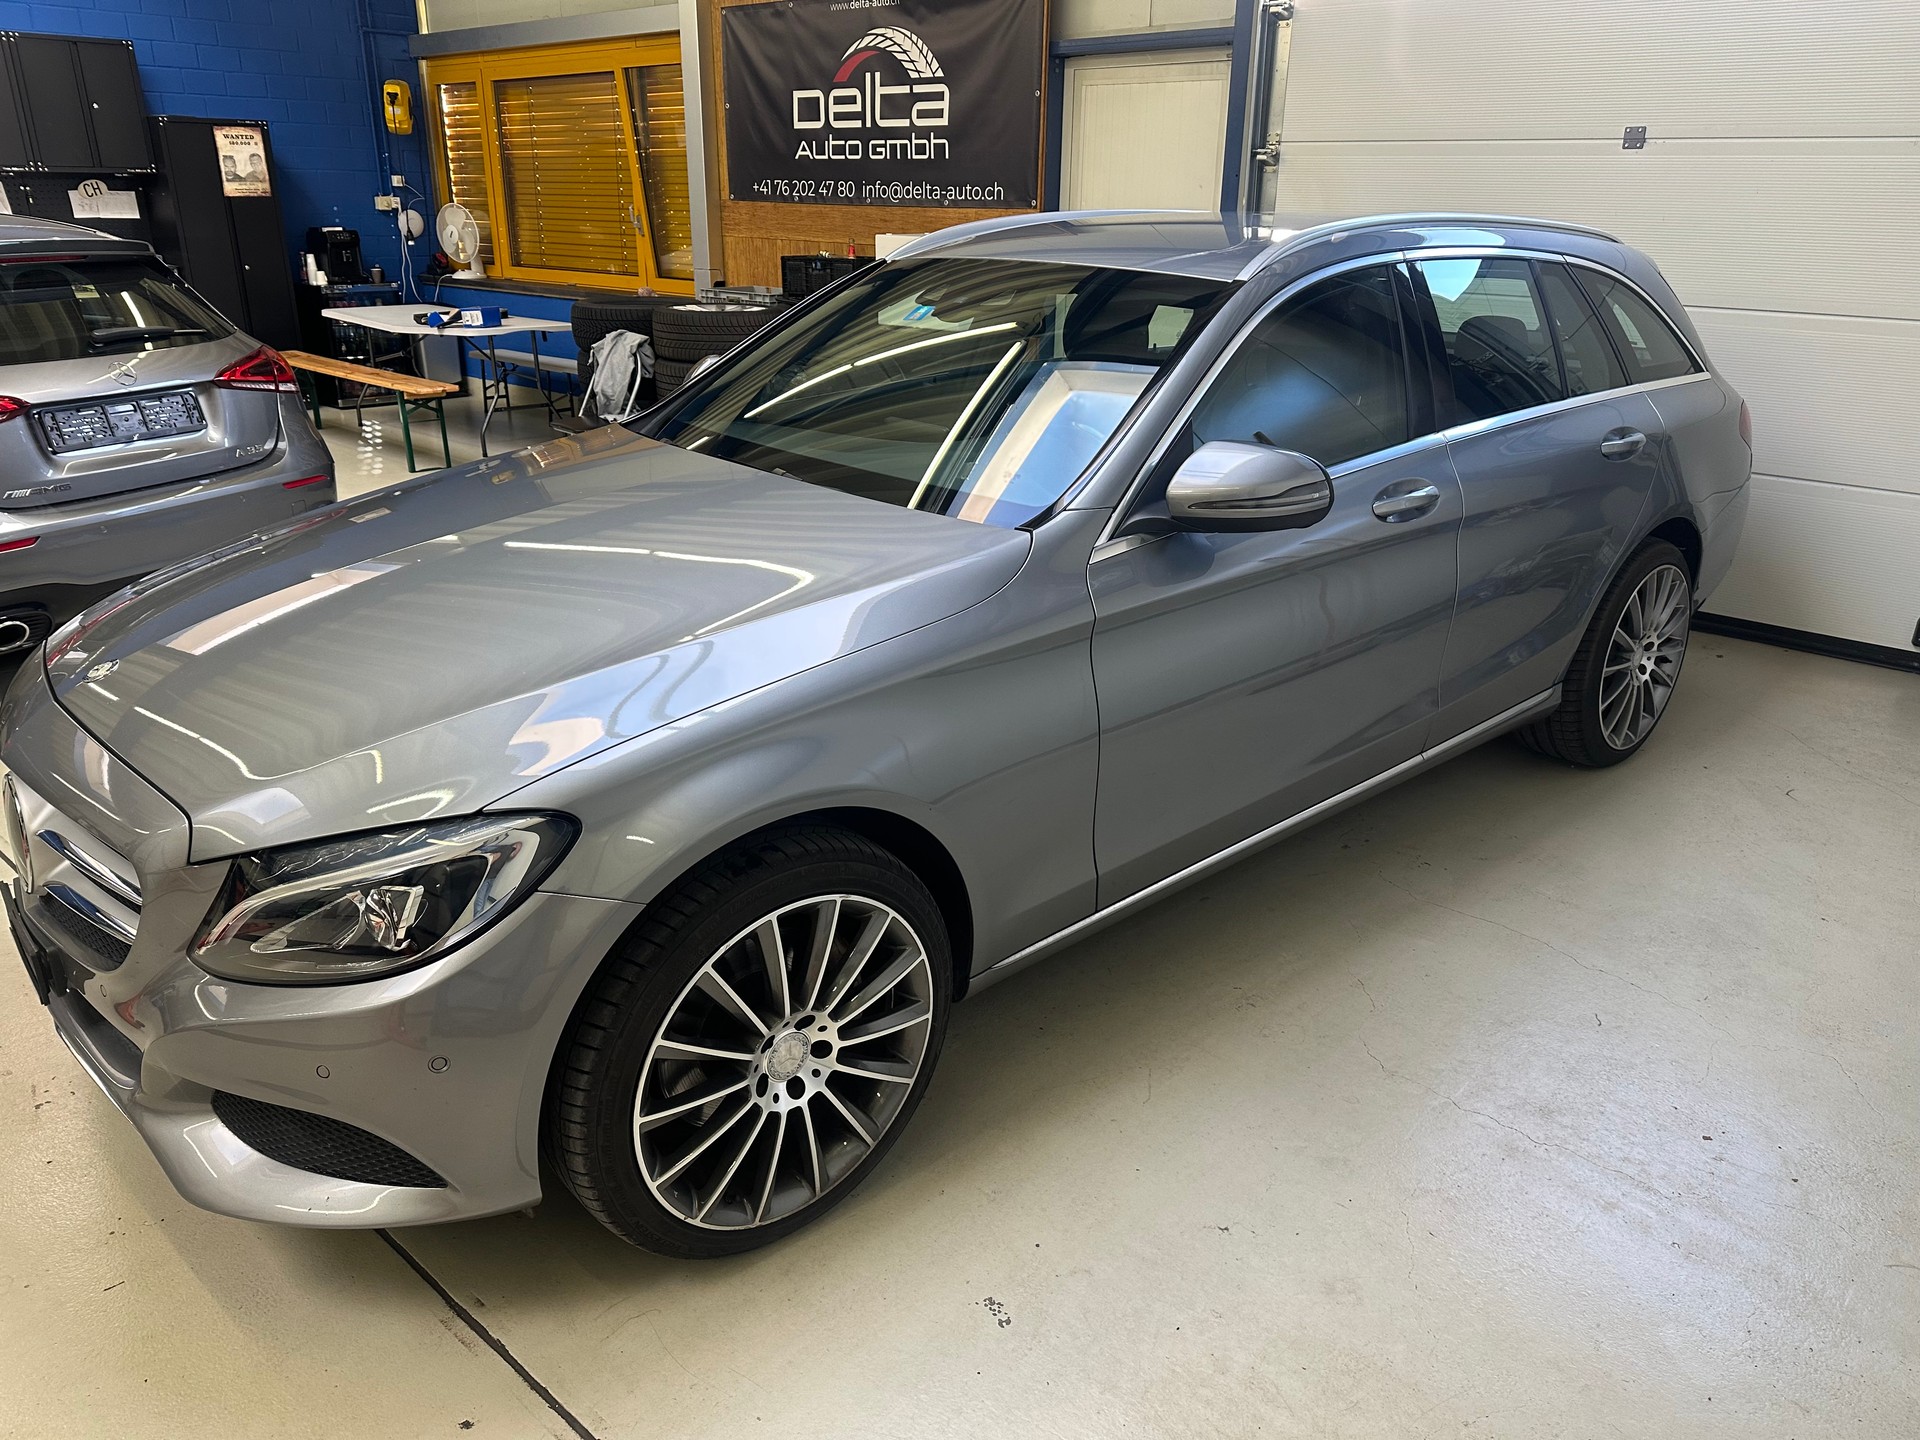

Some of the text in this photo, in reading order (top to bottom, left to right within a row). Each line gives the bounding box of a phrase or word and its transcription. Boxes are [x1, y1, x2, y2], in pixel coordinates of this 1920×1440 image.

[83, 181, 103, 198] CH
[752, 179, 1004, 202] +41 76 202 47 80 info@delta-auto.ch
